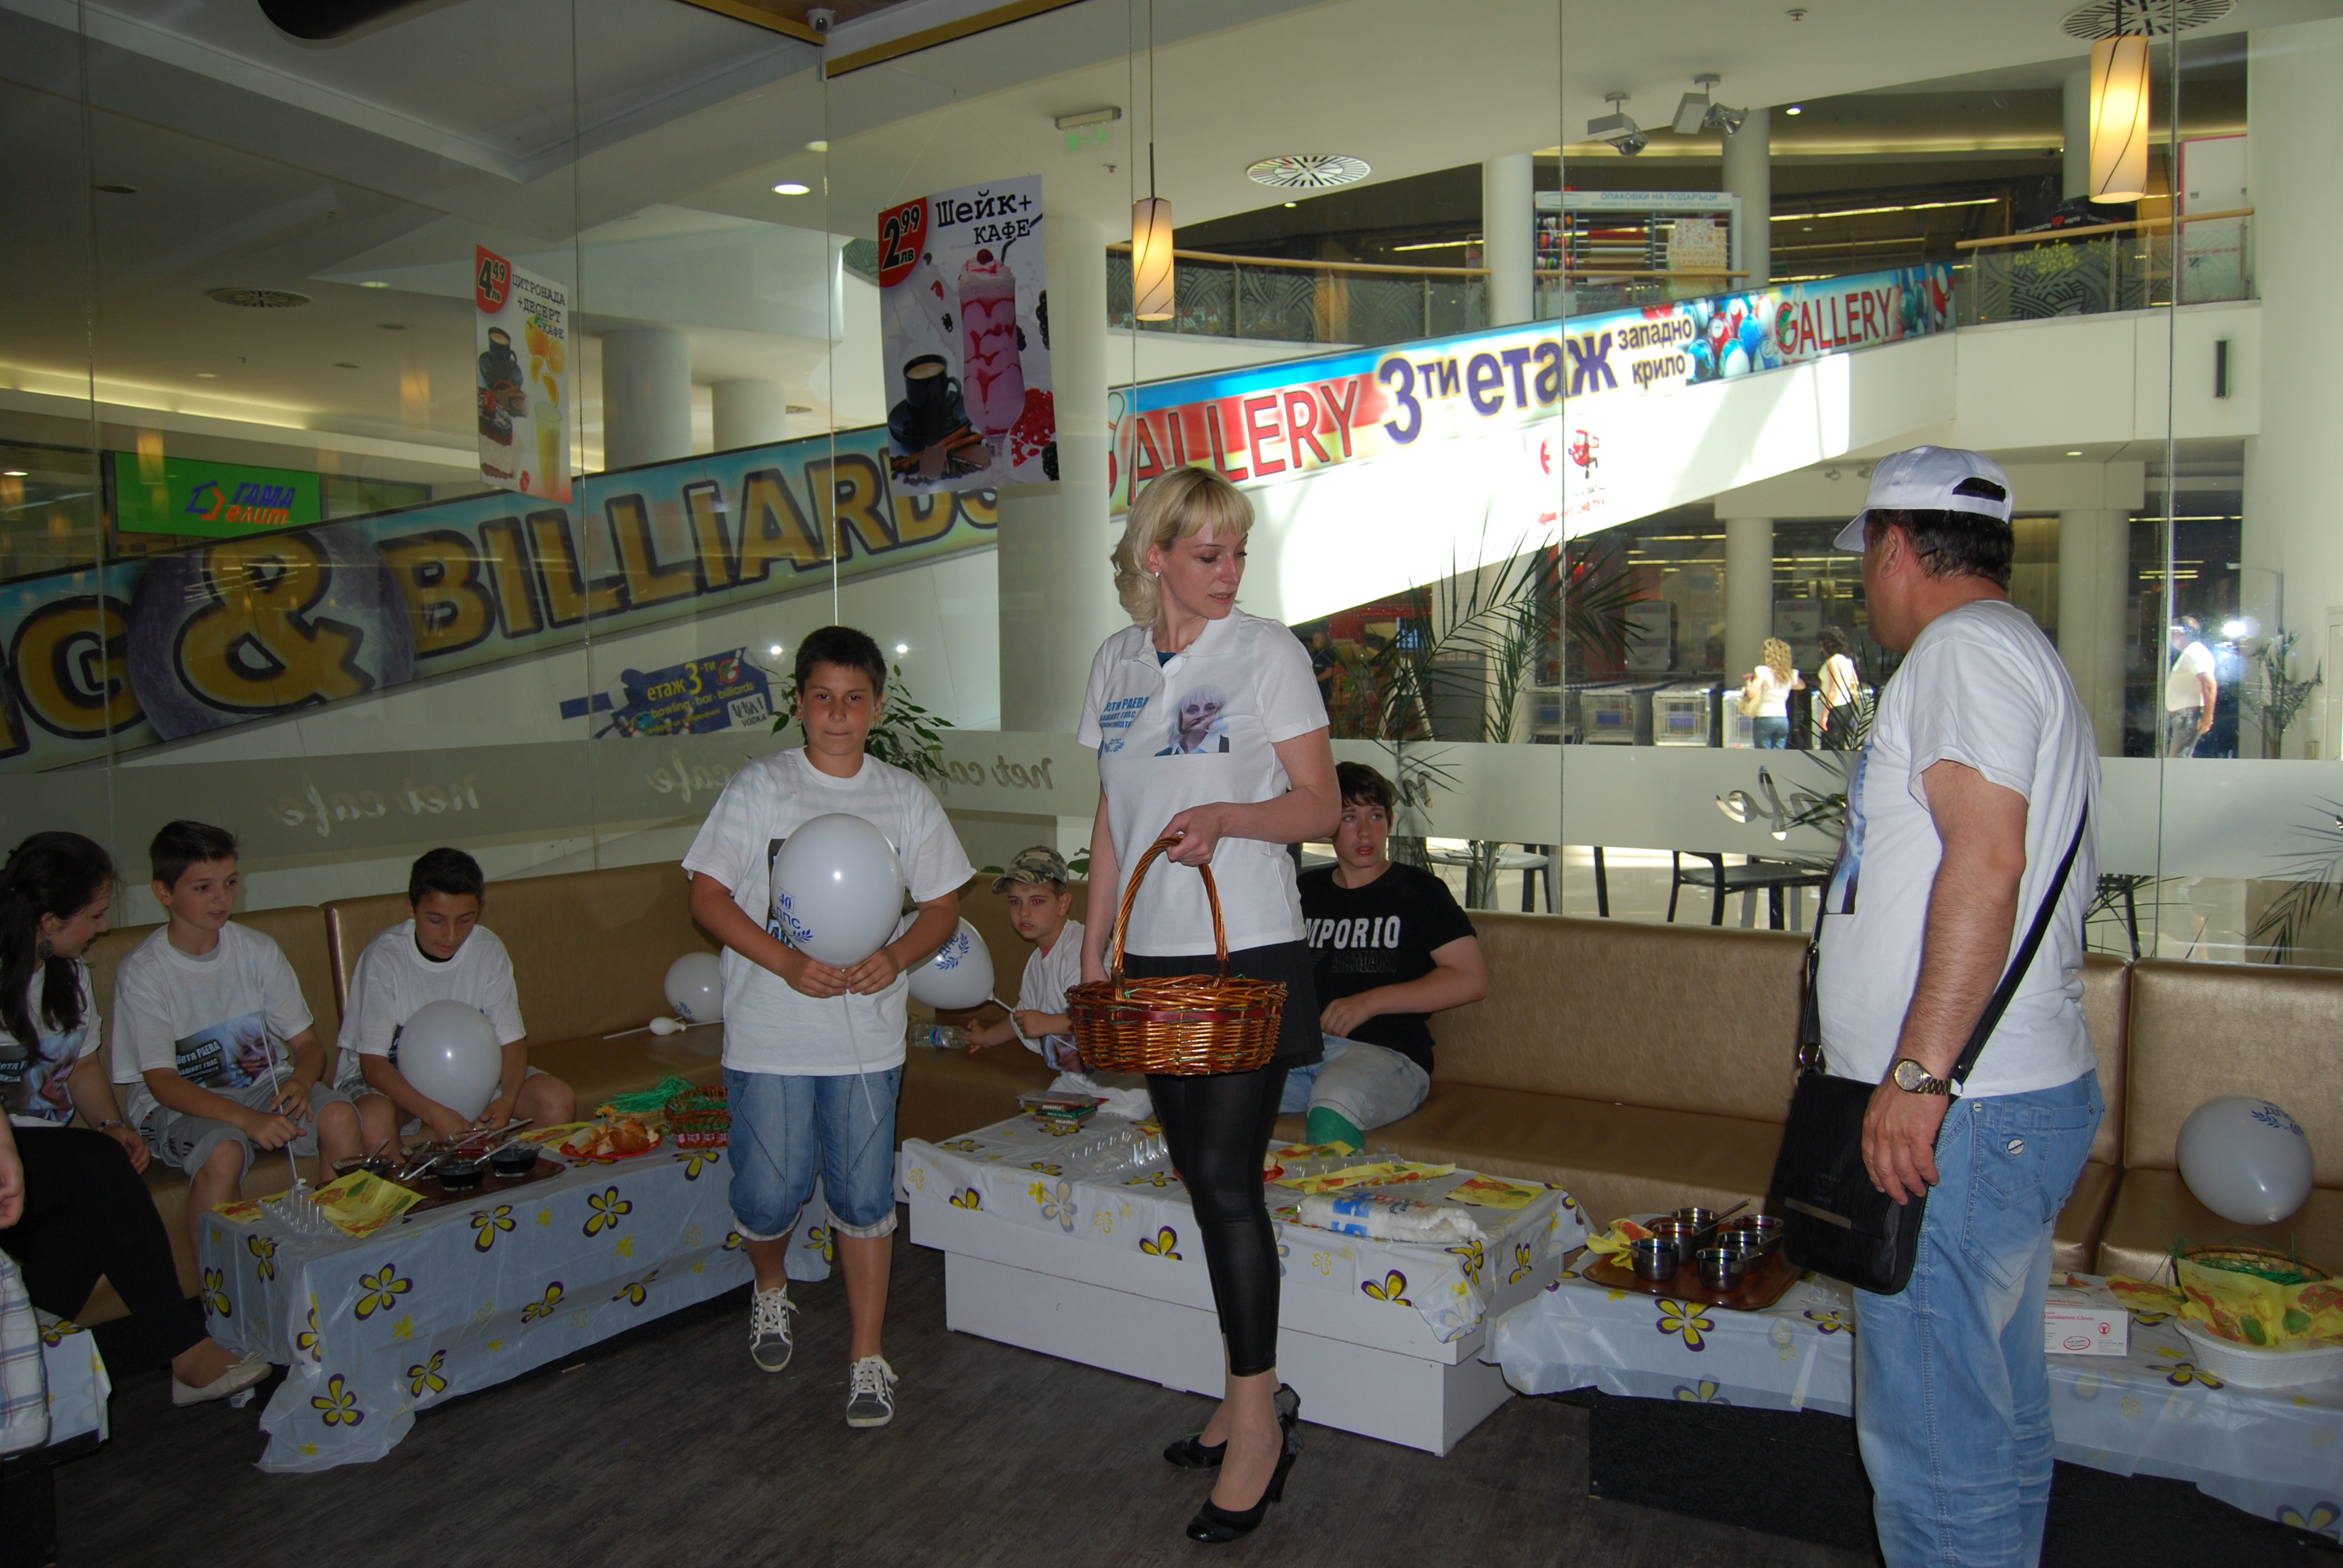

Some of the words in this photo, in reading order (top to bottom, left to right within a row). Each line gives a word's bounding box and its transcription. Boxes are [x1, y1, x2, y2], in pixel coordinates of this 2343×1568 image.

[936, 189, 1032, 228] Шейк+
[1668, 192, 1718, 201] ПОДАРЪЦИ
[974, 219, 1030, 245] КАФЕ
[513, 274, 566, 306] ЦИТРОНАДА
[1617, 318, 1693, 352] западно
[1775, 286, 1893, 356] GALLERY
[1632, 354, 1686, 389] крило
[231, 483, 297, 511] ГАМА
[647, 678, 687, 701] етаж
[650, 701, 692, 719] bowling
[696, 694, 713, 707] bar
[718, 681, 755, 700] billiards
[741, 713, 767, 727] VODKA
[1303, 915, 1401, 949] MPORIO
[197, 1040, 221, 1058] РАЕВА
